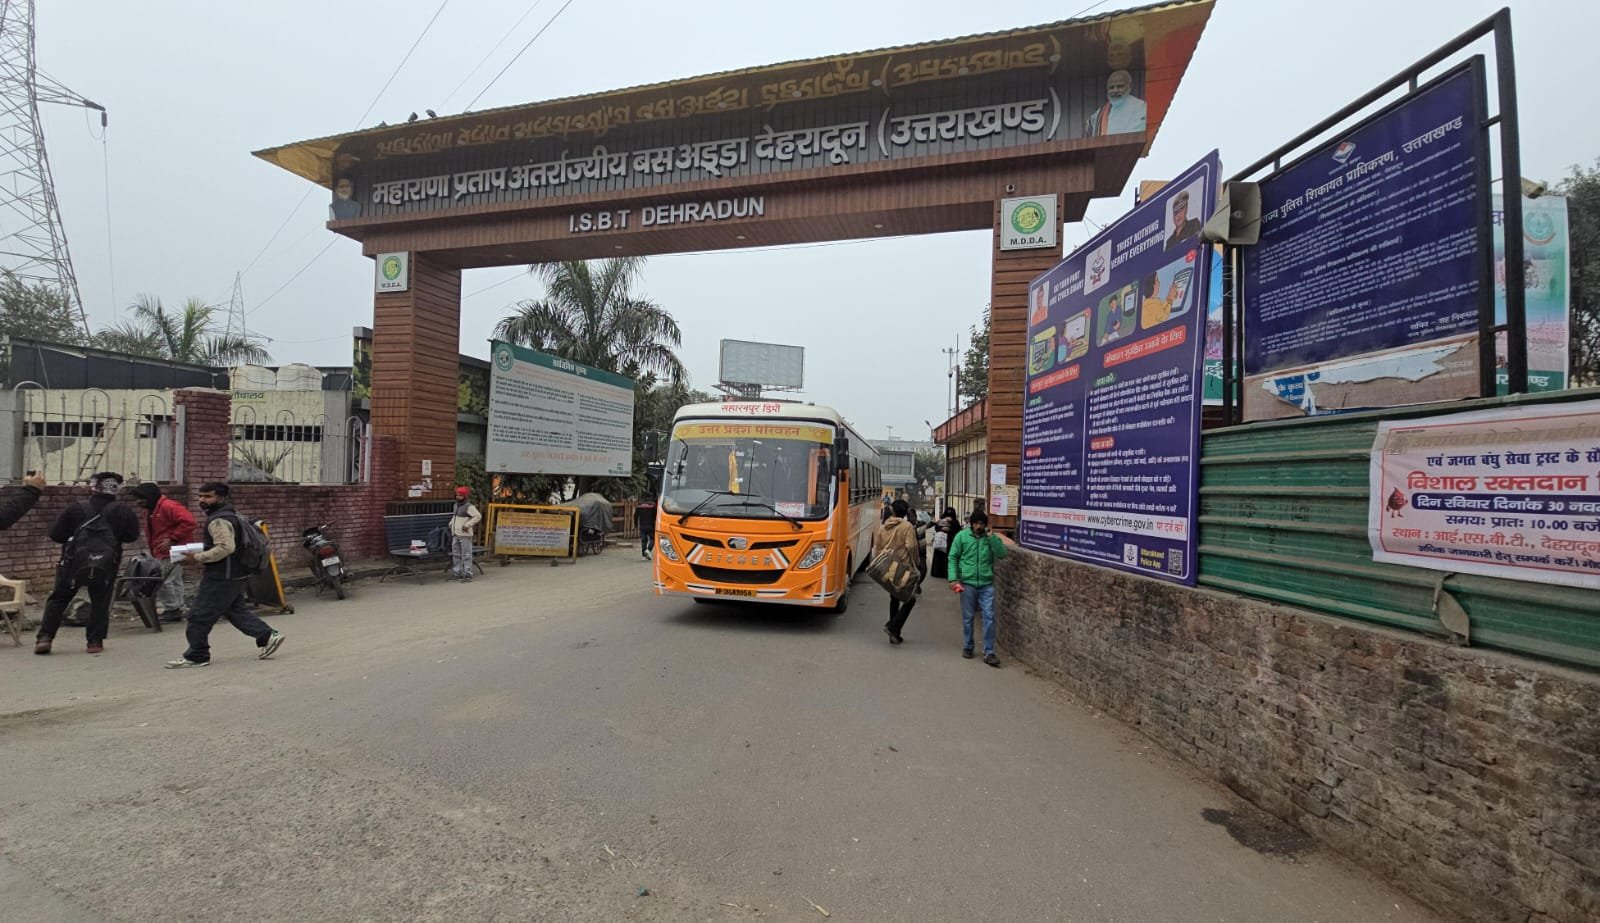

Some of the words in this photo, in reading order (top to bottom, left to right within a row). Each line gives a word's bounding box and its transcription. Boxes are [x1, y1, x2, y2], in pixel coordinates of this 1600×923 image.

[372, 174, 449, 206] महाराणा
[453, 168, 506, 201] प्रताप
[508, 145, 628, 191] अंतर्राज्यीय
[632, 146, 674, 176] बस
[755, 124, 868, 166] देहरादून
[877, 86, 1062, 157] (उत्तराखण्ड)
[1280, 196, 1304, 219] पुलिस
[1305, 175, 1344, 203] शिकायत
[1402, 116, 1463, 154] उत्तराखण्ड
[568, 208, 631, 235] I.S.B.T
[641, 197, 765, 227] DEHRADUN
[1010, 236, 1047, 246] M.D.D.A.
[1117, 235, 1133, 253] TRUST
[1134, 219, 1159, 243] NOTHING
[1129, 230, 1165, 258] EVERYTHING
[721, 404, 760, 415] सहारनपुर
[699, 425, 720, 434] उत्तर
[1427, 454, 1443, 466] एवं
[1447, 455, 1476, 466] जगत
[1505, 452, 1531, 465] सेवा
[1536, 450, 1560, 467] ट्रस्ट
[1564, 448, 1580, 463] के
[1407, 471, 1478, 491] विशाल
[1484, 476, 1588, 491] रक्तदान
[1417, 495, 1441, 508] दिन
[1445, 496, 1489, 509] रविवार
[1493, 497, 1543, 511] दिनांक
[1548, 501, 1564, 512] 30
[1087, 512, 1154, 533] www.cybercrime.gov.in
[1531, 519, 1568, 530] 10.00
[1572, 517, 1600, 532] बजे
[1392, 528, 1421, 539] स्थान
[1541, 535, 1600, 557] देहरादून
[705, 551, 773, 566] EICHER
[1447, 547, 1492, 559] जानकारी
[1515, 554, 1550, 565] सम्पर्क
